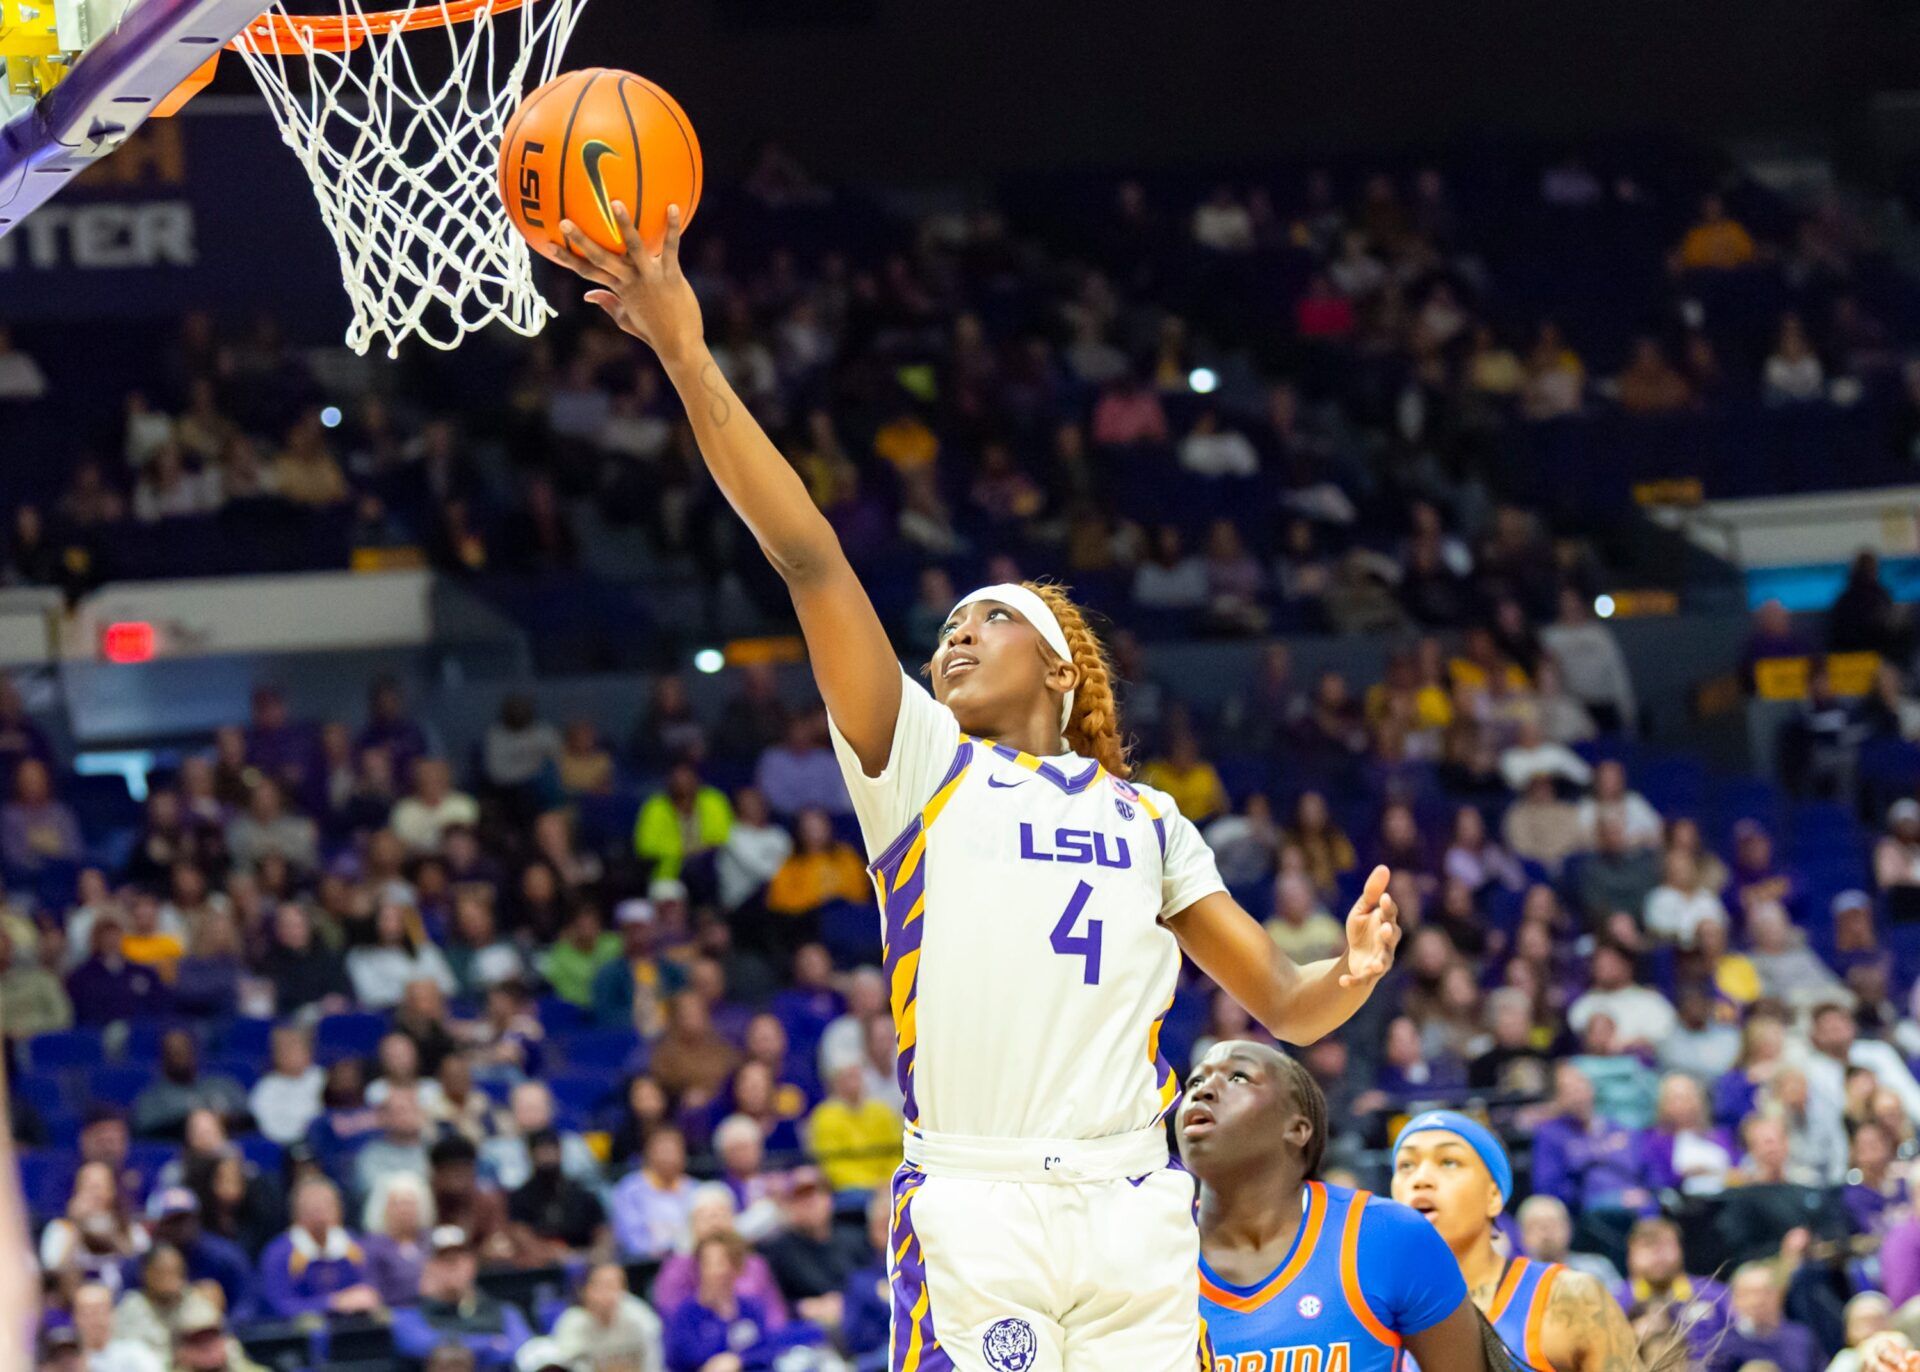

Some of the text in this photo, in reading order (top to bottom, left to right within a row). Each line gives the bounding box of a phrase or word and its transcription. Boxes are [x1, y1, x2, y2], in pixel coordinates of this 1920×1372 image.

[520, 140, 544, 228] LSU
[1020, 822, 1132, 869] LSU
[1049, 879, 1103, 985] 4
